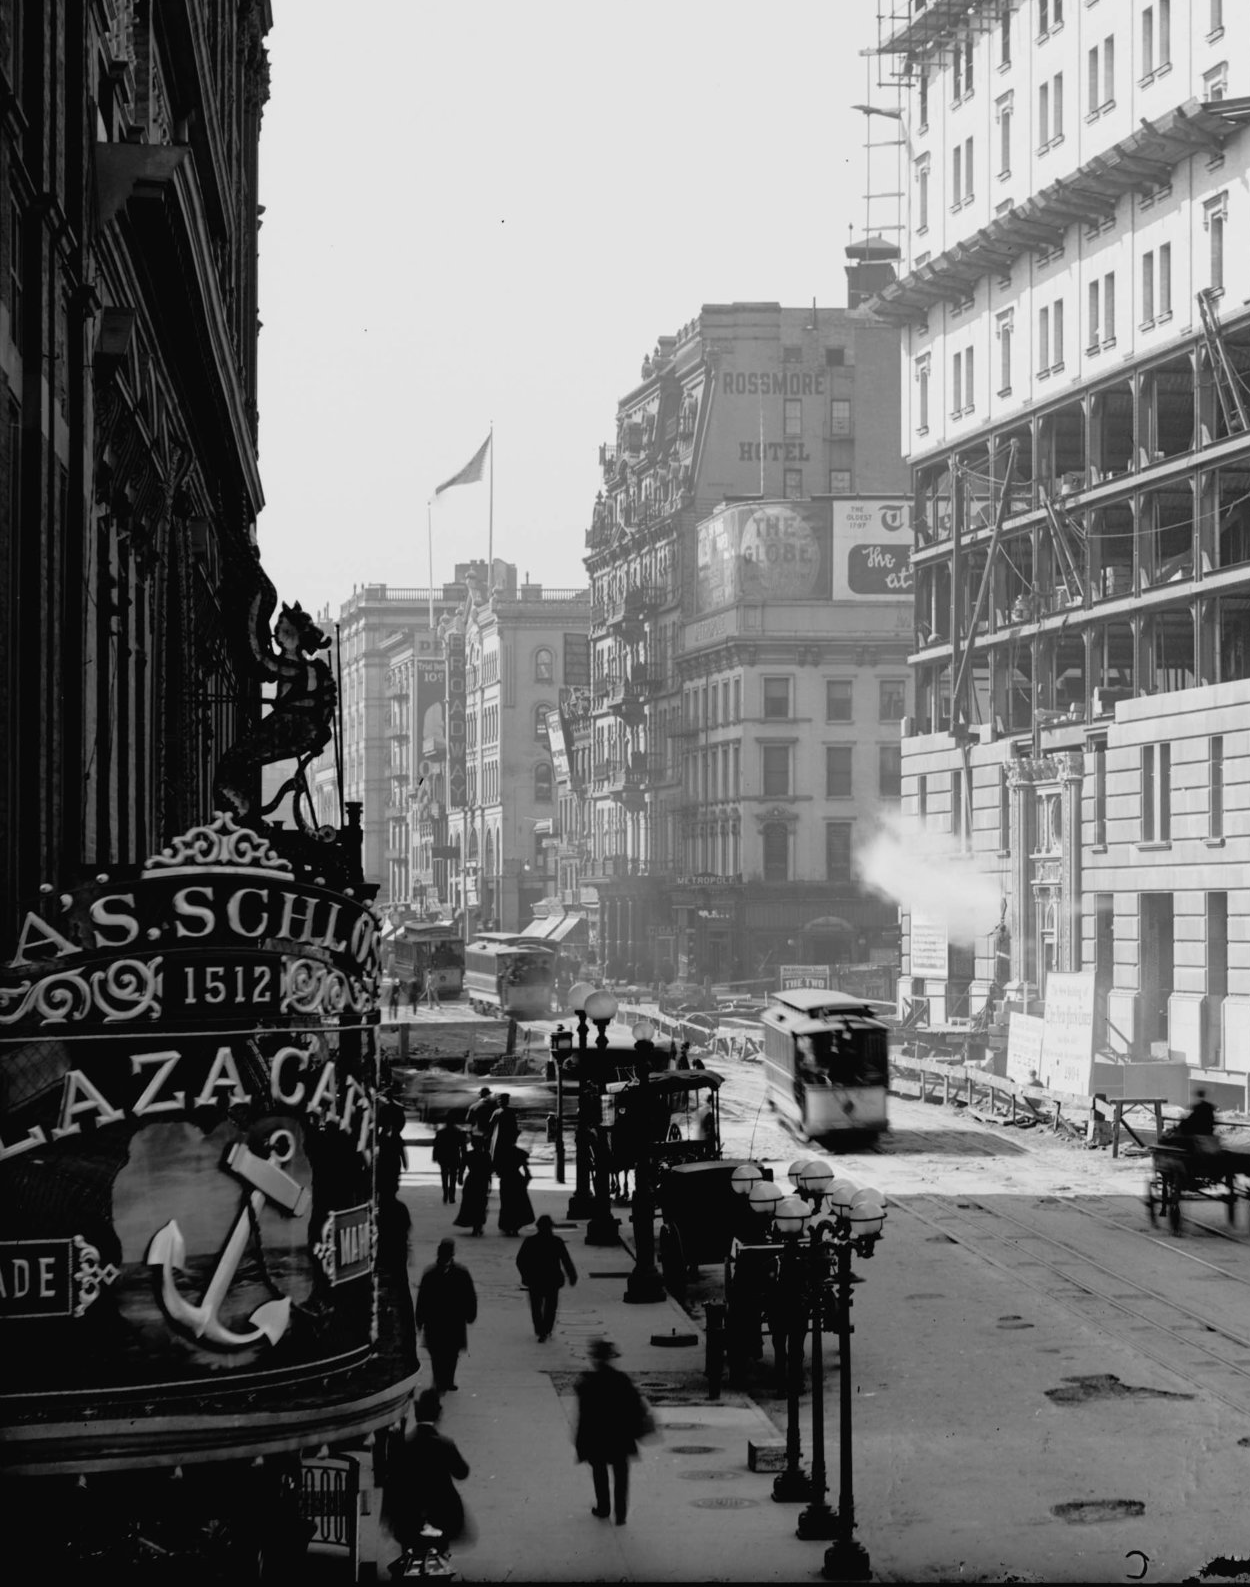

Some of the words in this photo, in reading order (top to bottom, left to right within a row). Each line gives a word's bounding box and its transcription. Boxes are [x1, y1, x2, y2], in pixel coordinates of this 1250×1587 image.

[722, 372, 825, 395] ROSSMORE
[738, 442, 811, 462] HOTEL
[862, 546, 896, 568] The
[449, 634, 465, 804] BROADWAY
[183, 965, 272, 1004] 1512
[785, 979, 803, 989] THE
[805, 978, 824, 989] TWO
